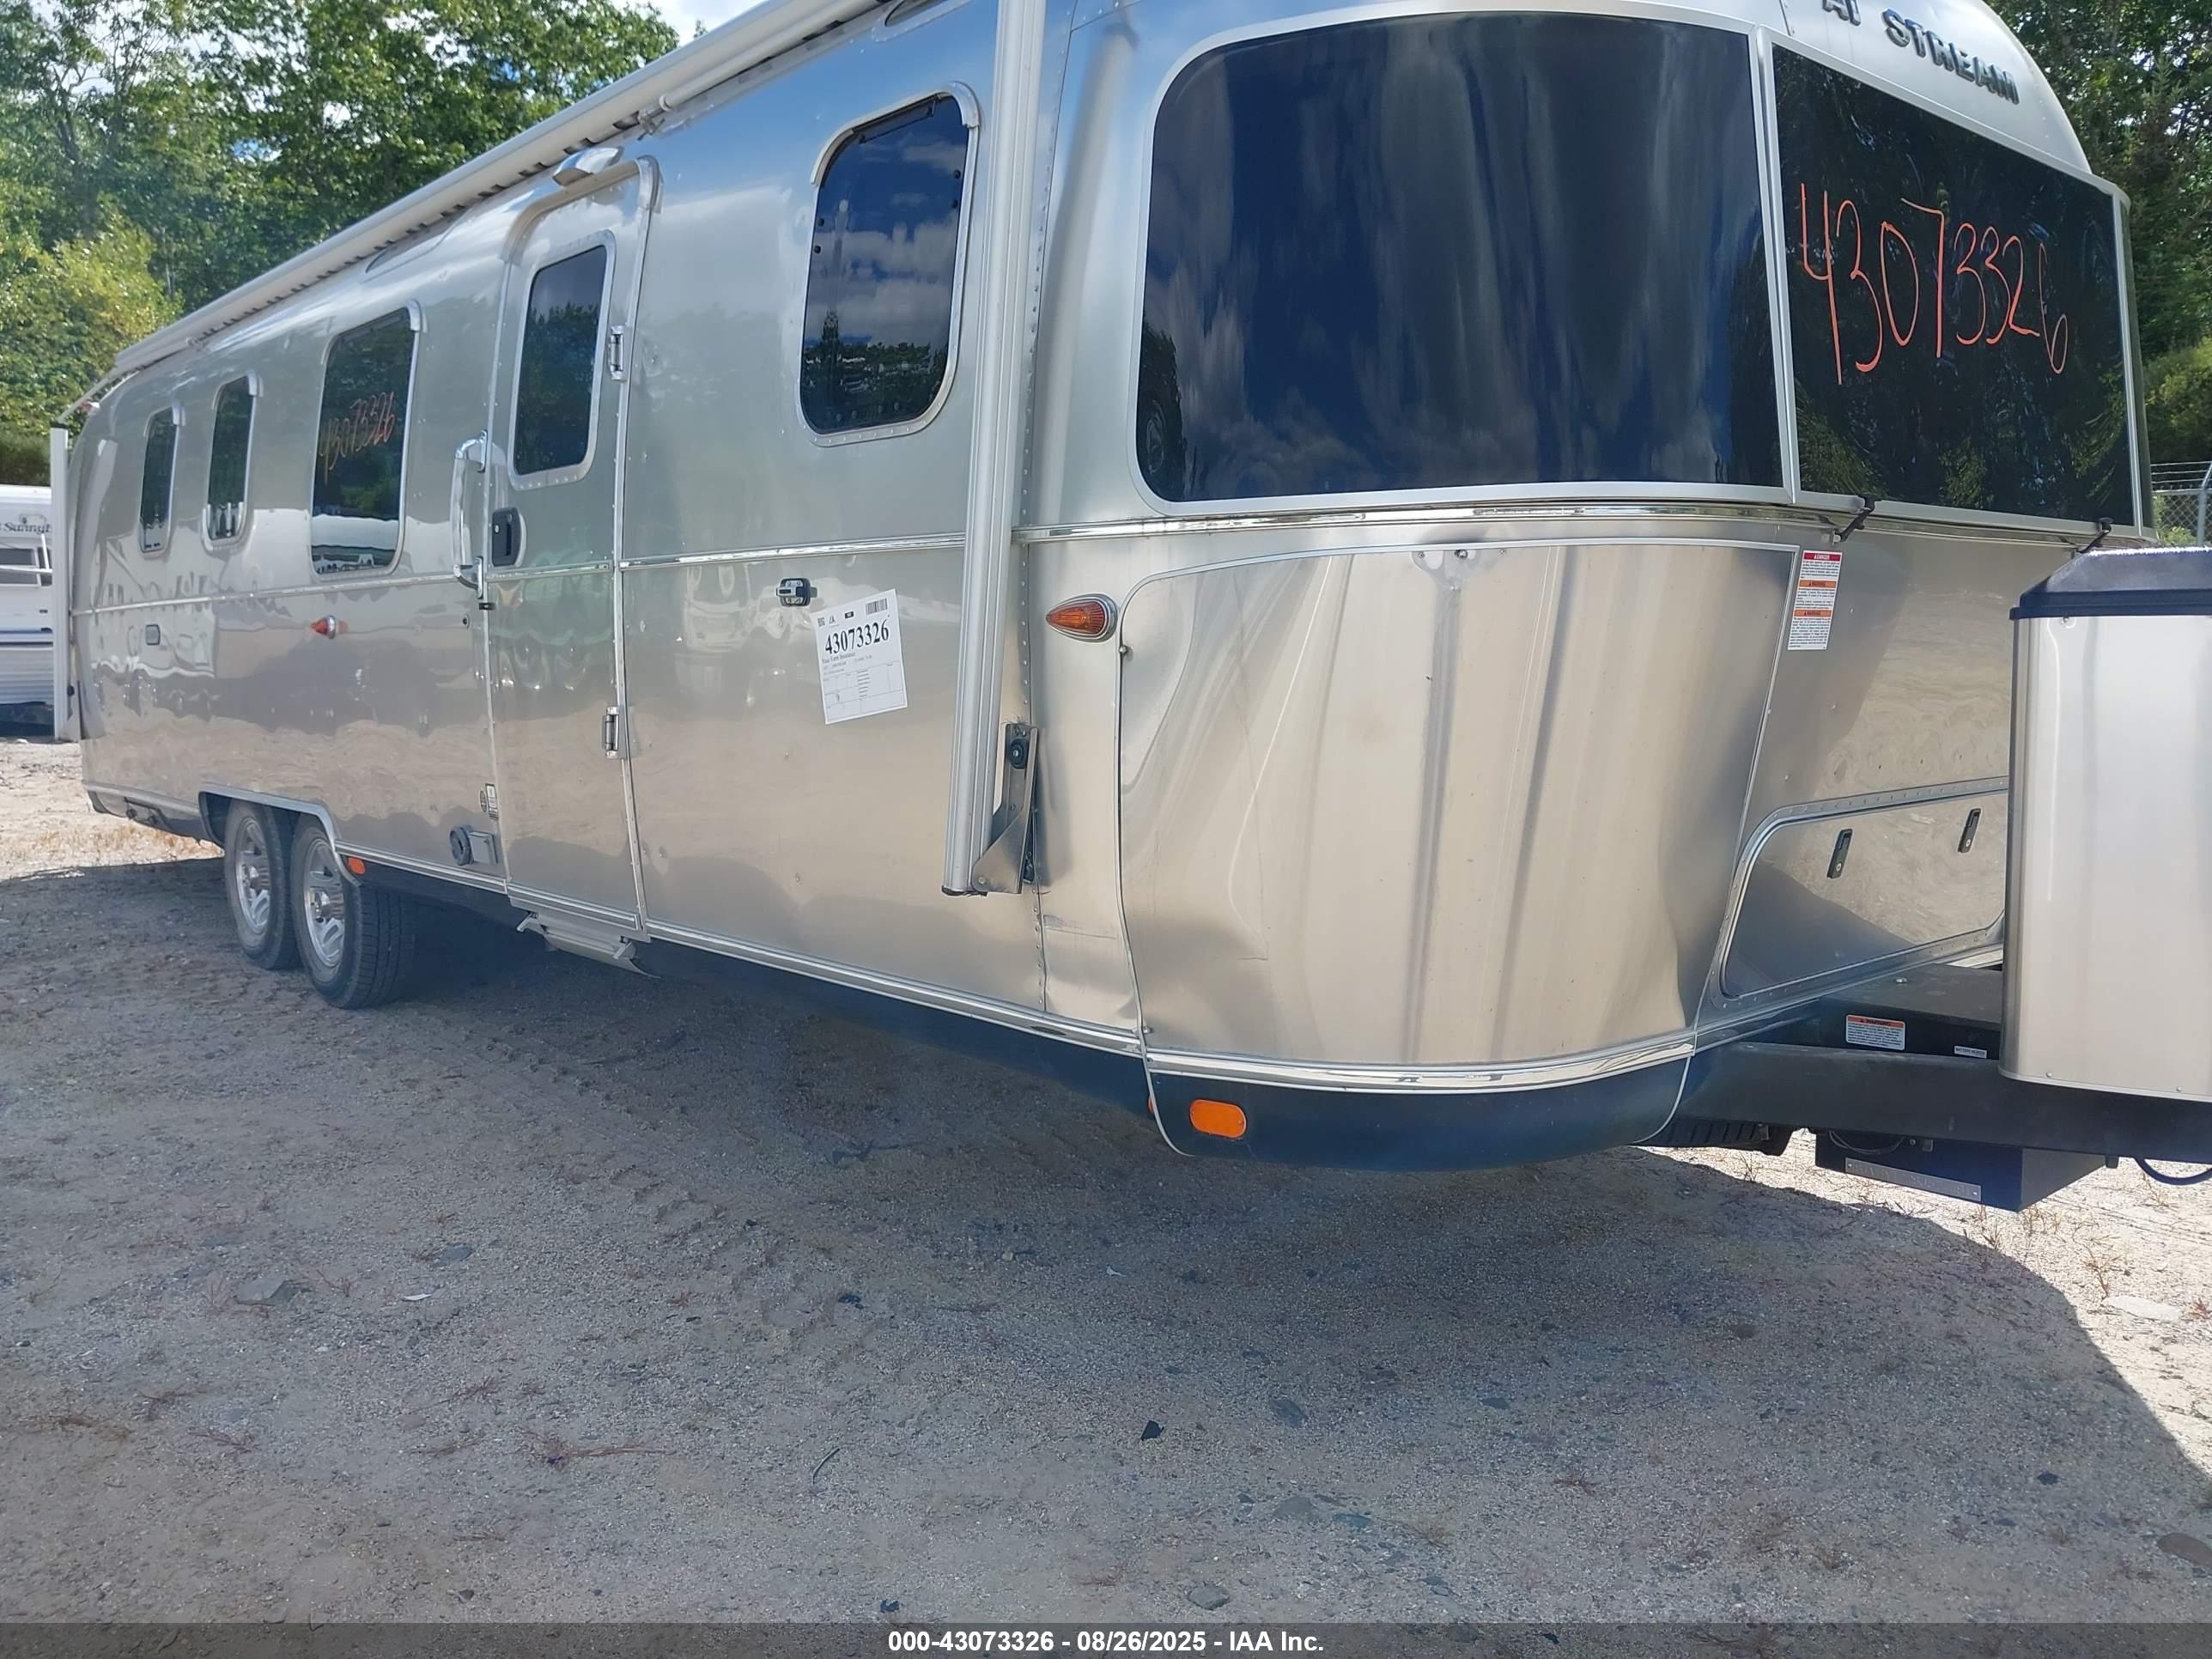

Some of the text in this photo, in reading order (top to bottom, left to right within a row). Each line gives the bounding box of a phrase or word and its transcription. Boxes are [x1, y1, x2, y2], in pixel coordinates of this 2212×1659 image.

[1881, 8, 2020, 105] STREAM
[1801, 183, 2068, 385] 43073326
[825, 619, 889, 654] 43073326
